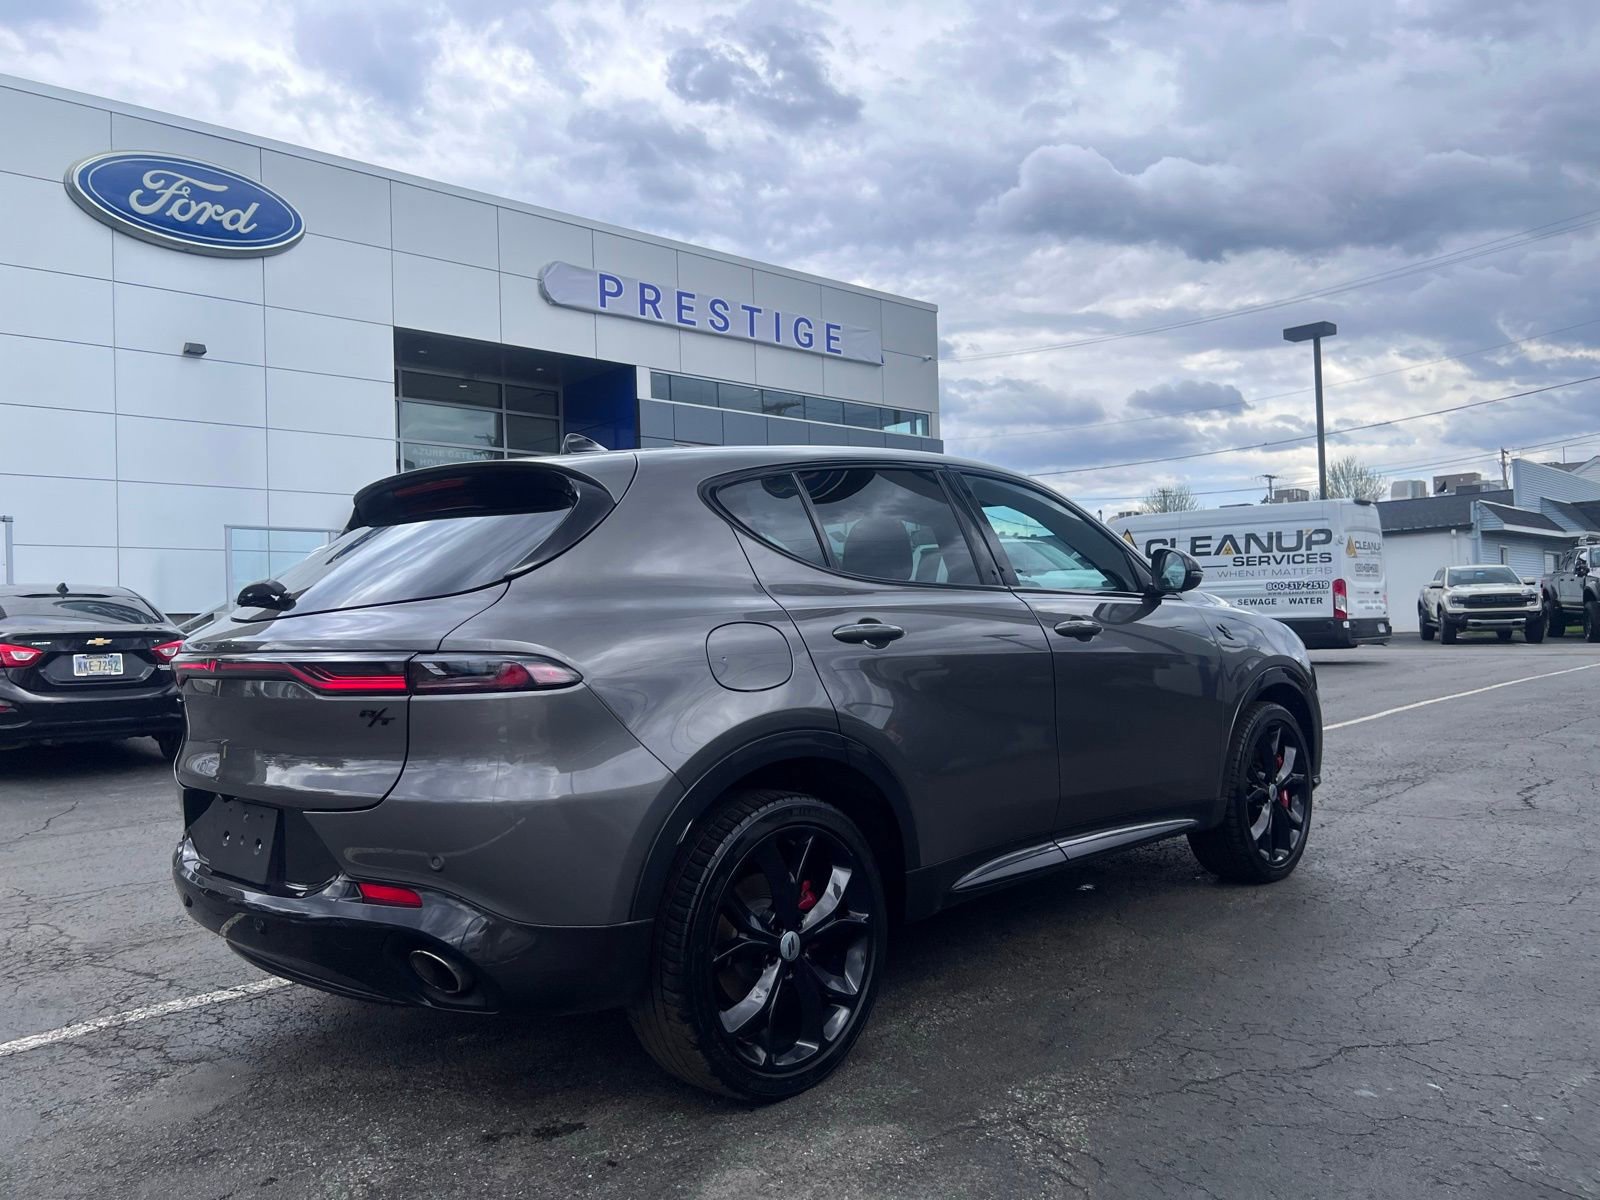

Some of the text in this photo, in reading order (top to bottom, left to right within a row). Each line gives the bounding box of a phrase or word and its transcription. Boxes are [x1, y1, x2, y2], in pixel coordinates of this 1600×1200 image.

[129, 170, 260, 234] Ford
[598, 273, 843, 356] PRESTIGE
[1354, 540, 1382, 551] CLEANU
[1232, 552, 1333, 567] SERVICES
[1258, 569, 1267, 577] IT
[1271, 566, 1333, 576] MATTERS
[1237, 597, 1323, 606] SEWAGE WATER
